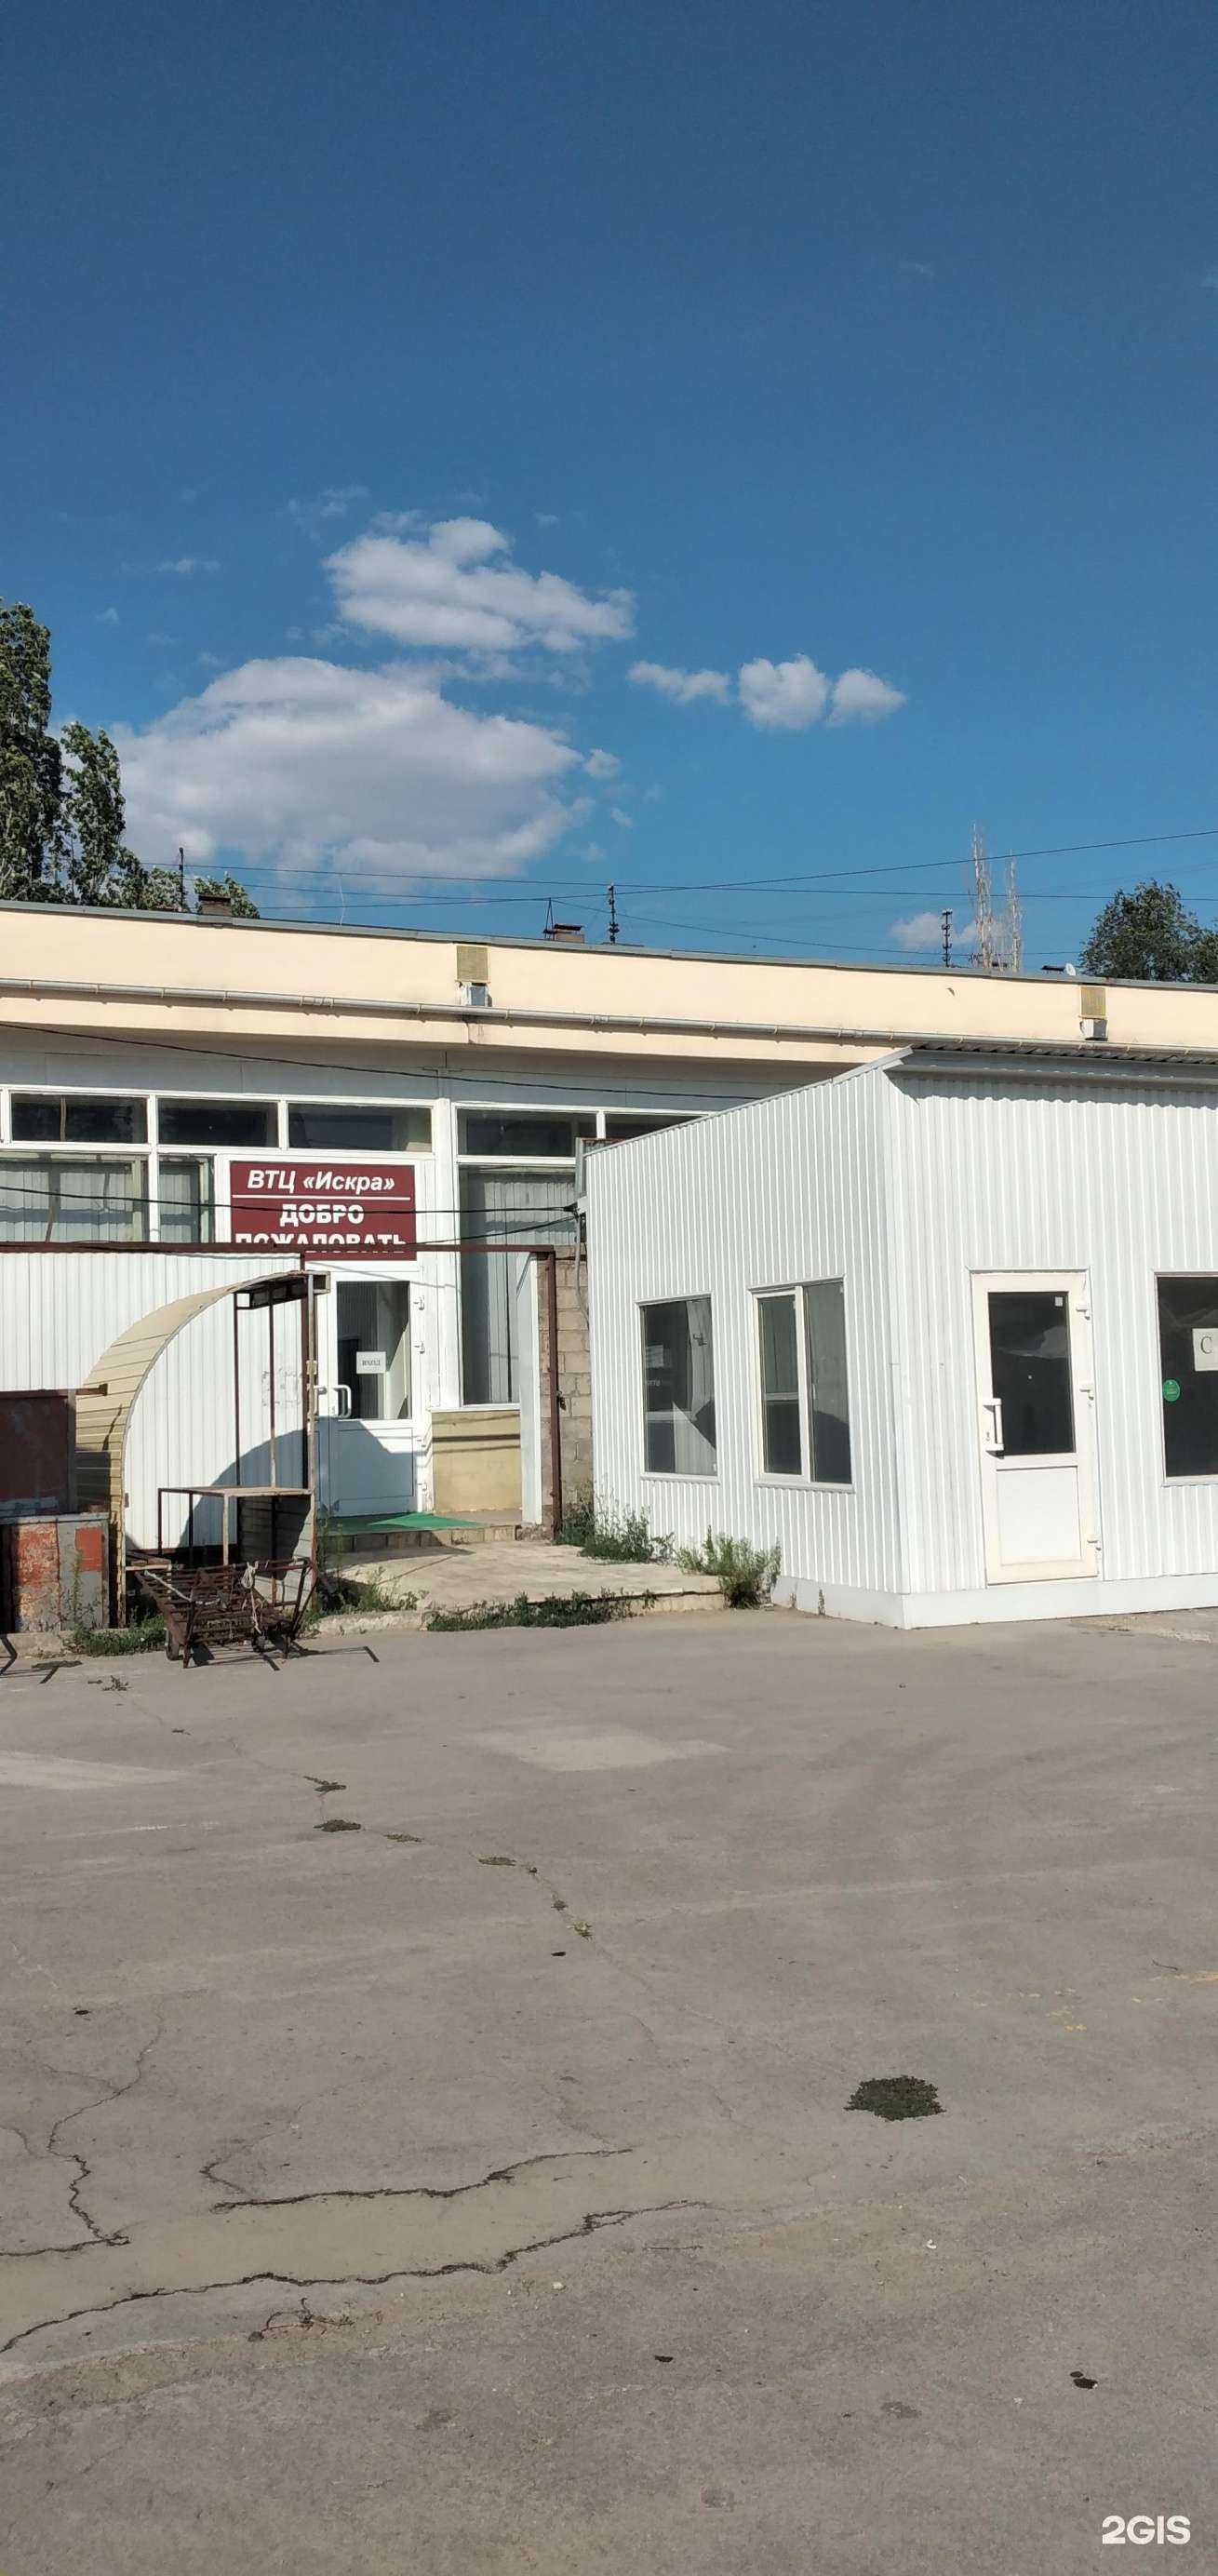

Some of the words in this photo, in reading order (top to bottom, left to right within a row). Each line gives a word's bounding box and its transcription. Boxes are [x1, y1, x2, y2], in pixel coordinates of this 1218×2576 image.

[248, 1170, 296, 1194] ВТЦ
[303, 1171, 395, 1195] «Искра»
[280, 1203, 365, 1227] ДОБРО
